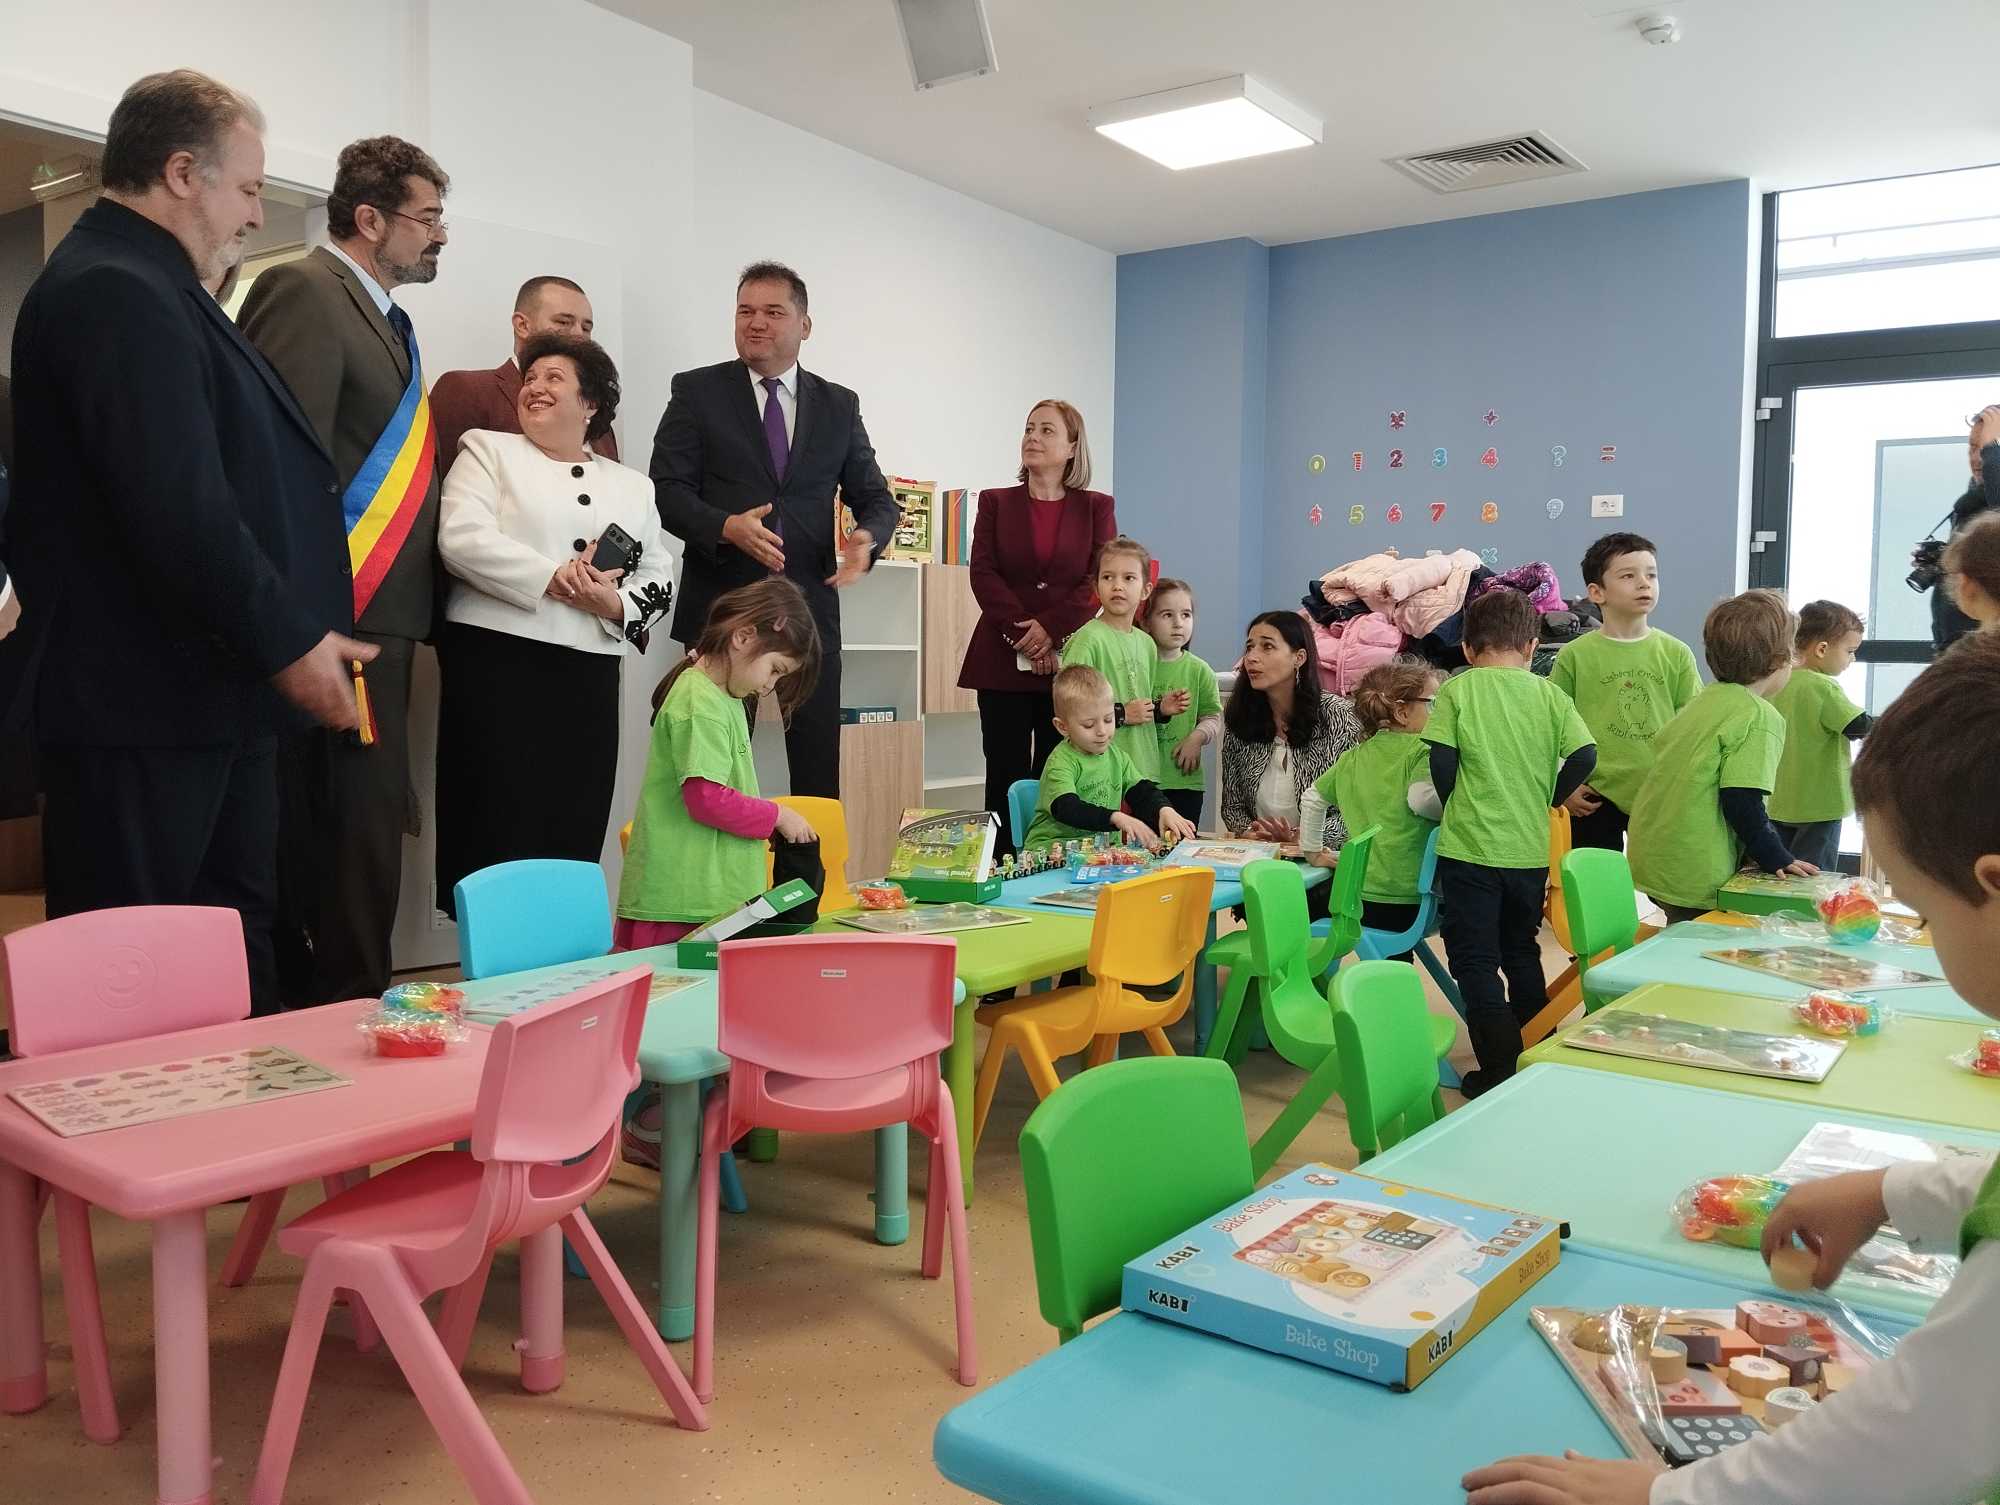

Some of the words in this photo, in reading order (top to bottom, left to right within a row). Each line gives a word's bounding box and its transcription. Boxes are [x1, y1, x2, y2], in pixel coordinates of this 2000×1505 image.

[1352, 451, 1364, 472] 1
[1389, 448, 1405, 469] 2
[1431, 447, 1448, 469] 3
[1480, 447, 1499, 469] 4
[1349, 504, 1365, 525] 5
[1386, 503, 1404, 524] 6
[1430, 502, 1448, 523] 7
[1481, 502, 1499, 523] 8
[1213, 1210, 1253, 1233] Bake
[1244, 1196, 1288, 1215] Shop
[1284, 1323, 1328, 1352] Bake
[1333, 1337, 1380, 1374] Shop
